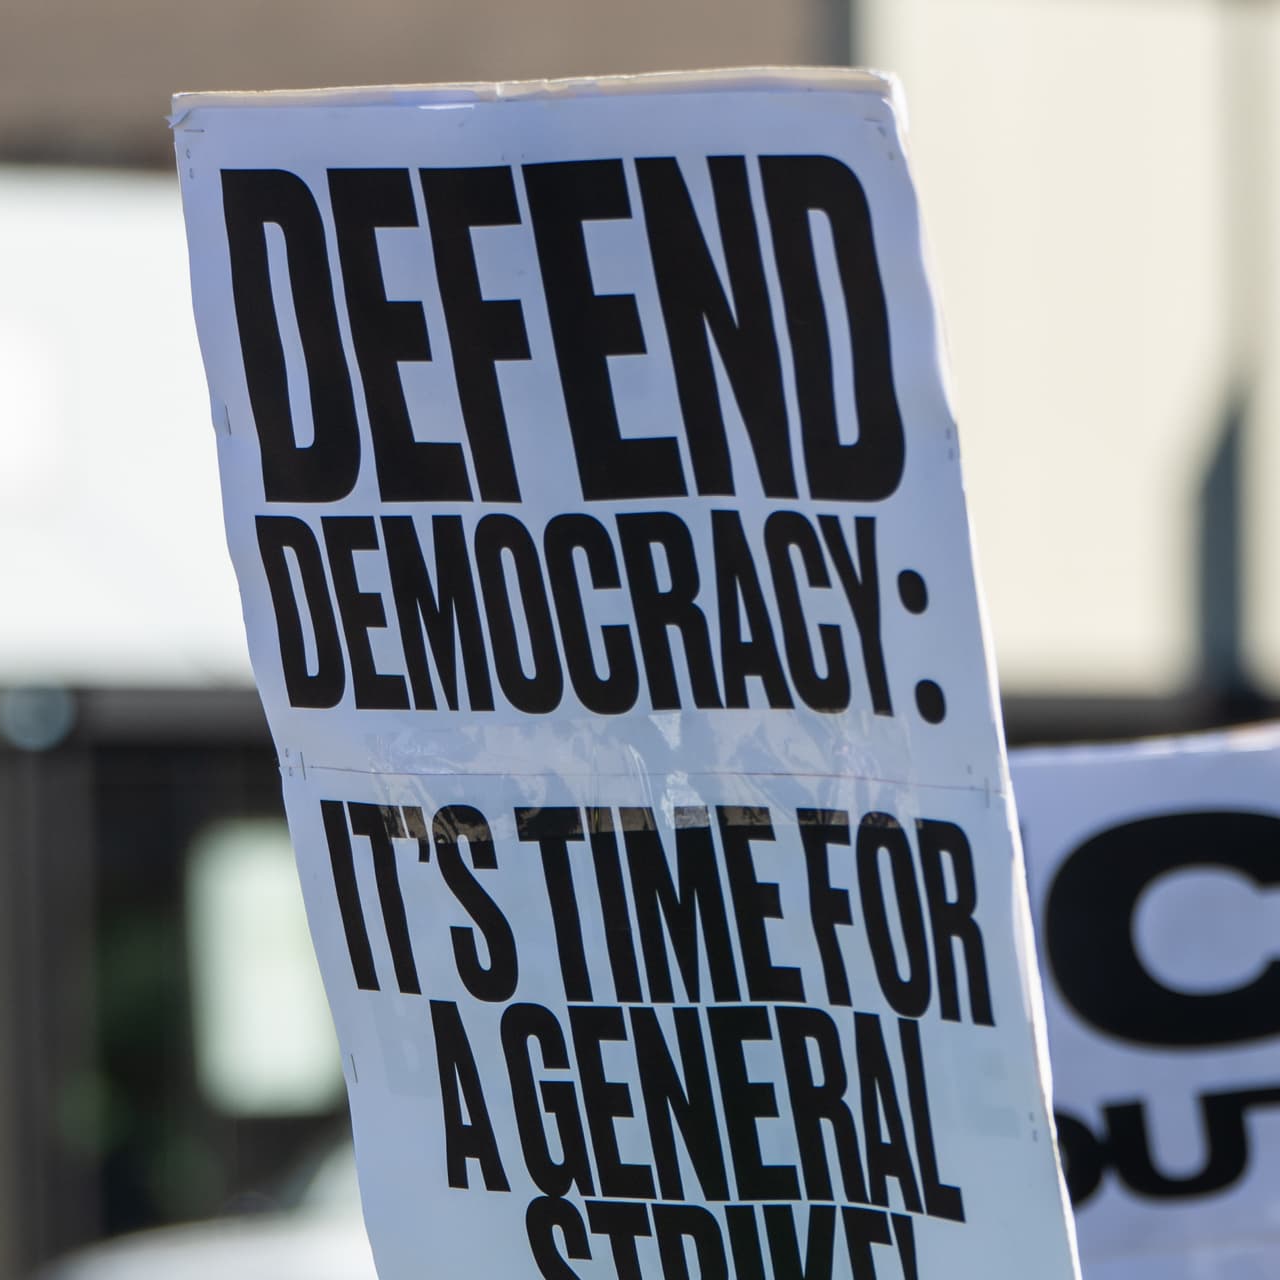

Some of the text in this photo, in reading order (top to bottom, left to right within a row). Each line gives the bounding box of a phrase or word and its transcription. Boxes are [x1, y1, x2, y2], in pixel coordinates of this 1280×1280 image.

[218, 153, 907, 504] DEFEND
[254, 509, 947, 725] DEMOCRACY:
[319, 798, 997, 1028] IT'S TIME FOR
[429, 999, 966, 1223] A GENERAL
